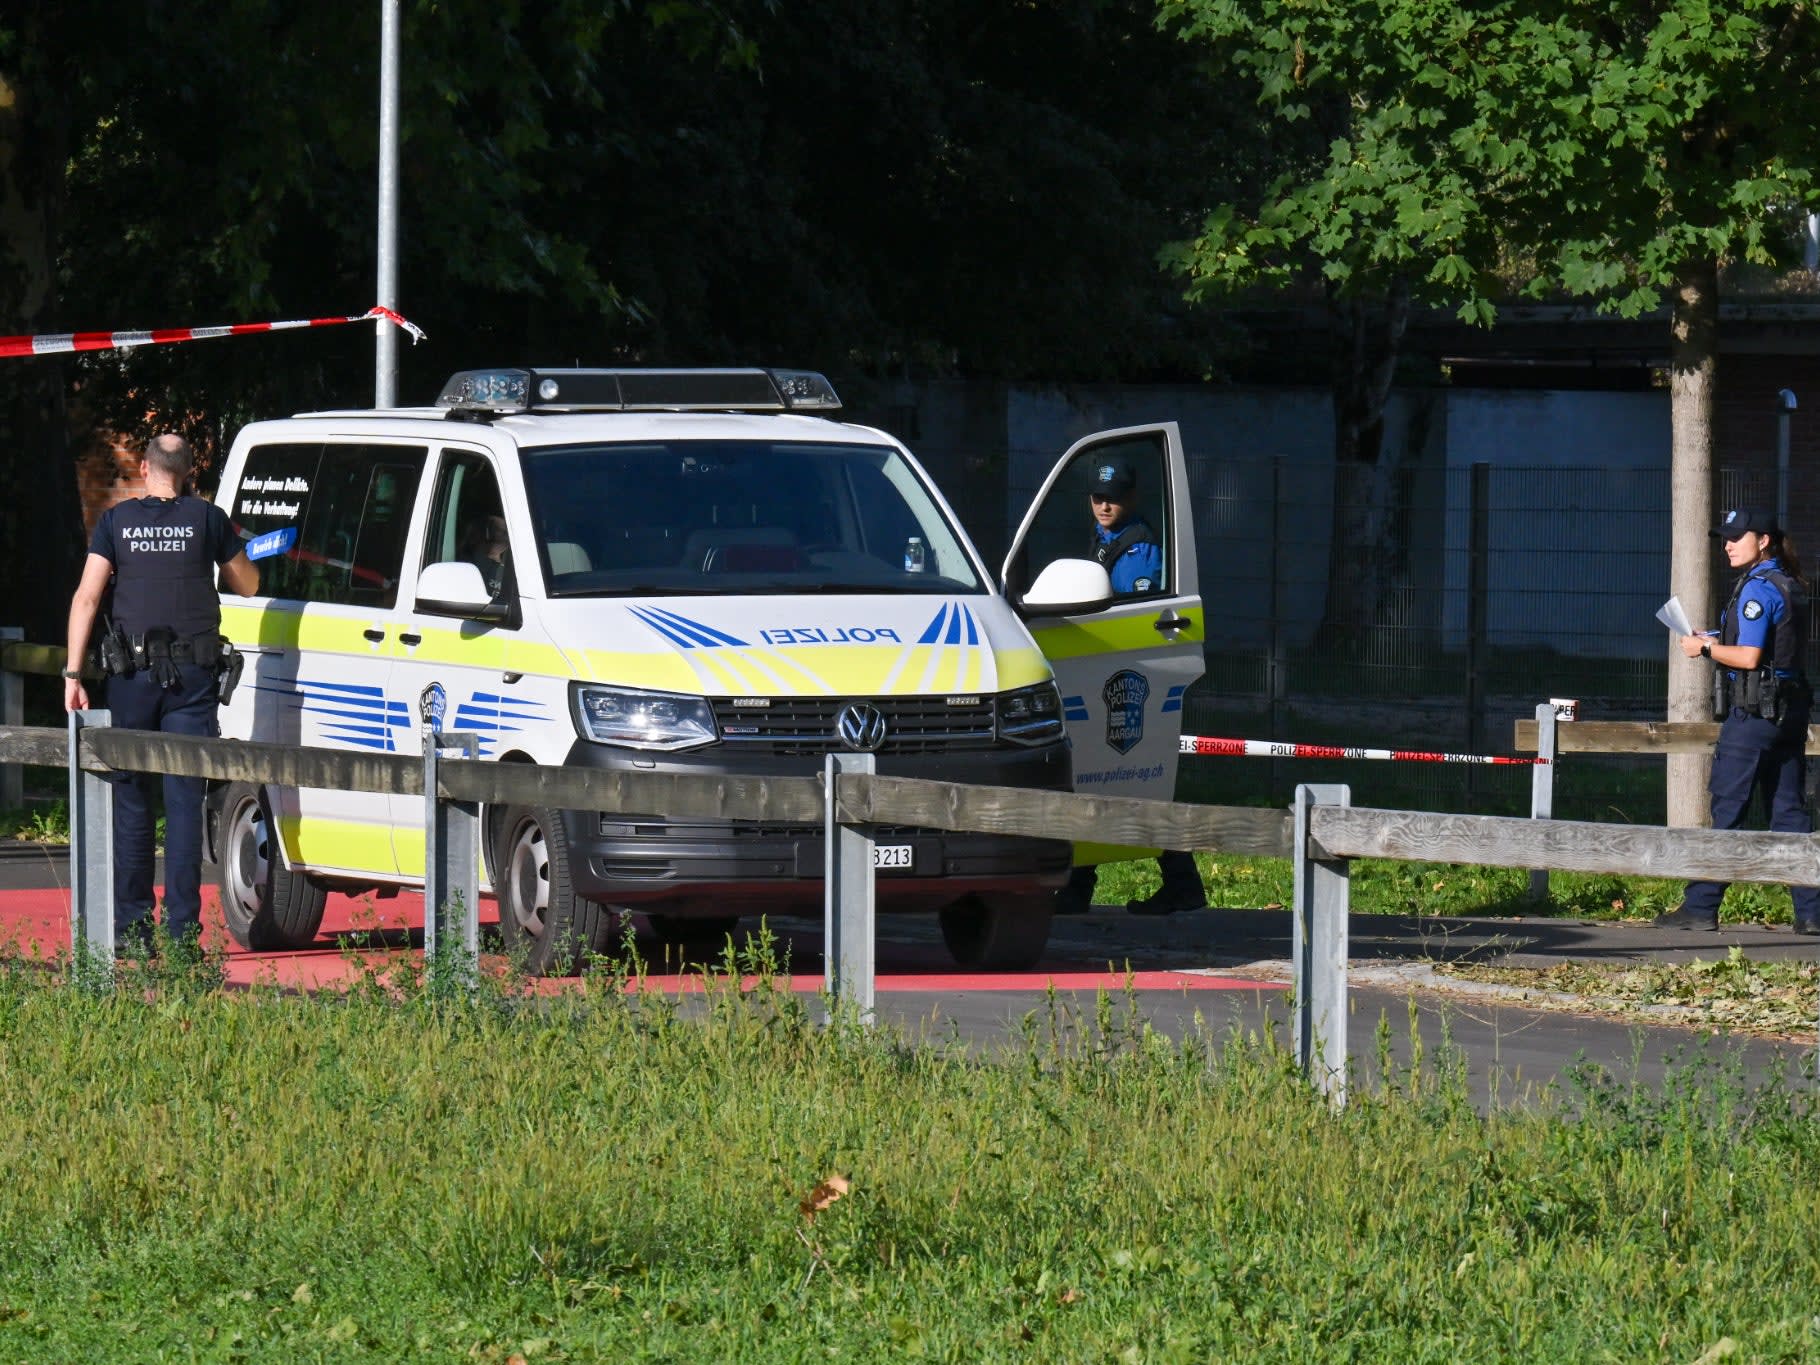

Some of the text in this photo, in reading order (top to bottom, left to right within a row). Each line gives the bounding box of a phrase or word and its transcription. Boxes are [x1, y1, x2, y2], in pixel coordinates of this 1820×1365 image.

[241, 500, 252, 514] Wir
[122, 526, 194, 539] KANTONS
[130, 540, 186, 553] POLIZEI
[1106, 678, 1146, 700] KANTONS
[1110, 692, 1144, 708] POLIZEI
[1109, 727, 1144, 739] AARGAU
[1270, 744, 1367, 759] POLIZEI-SPERRZONE
[1076, 764, 1165, 784] www.polizei-ag.ch
